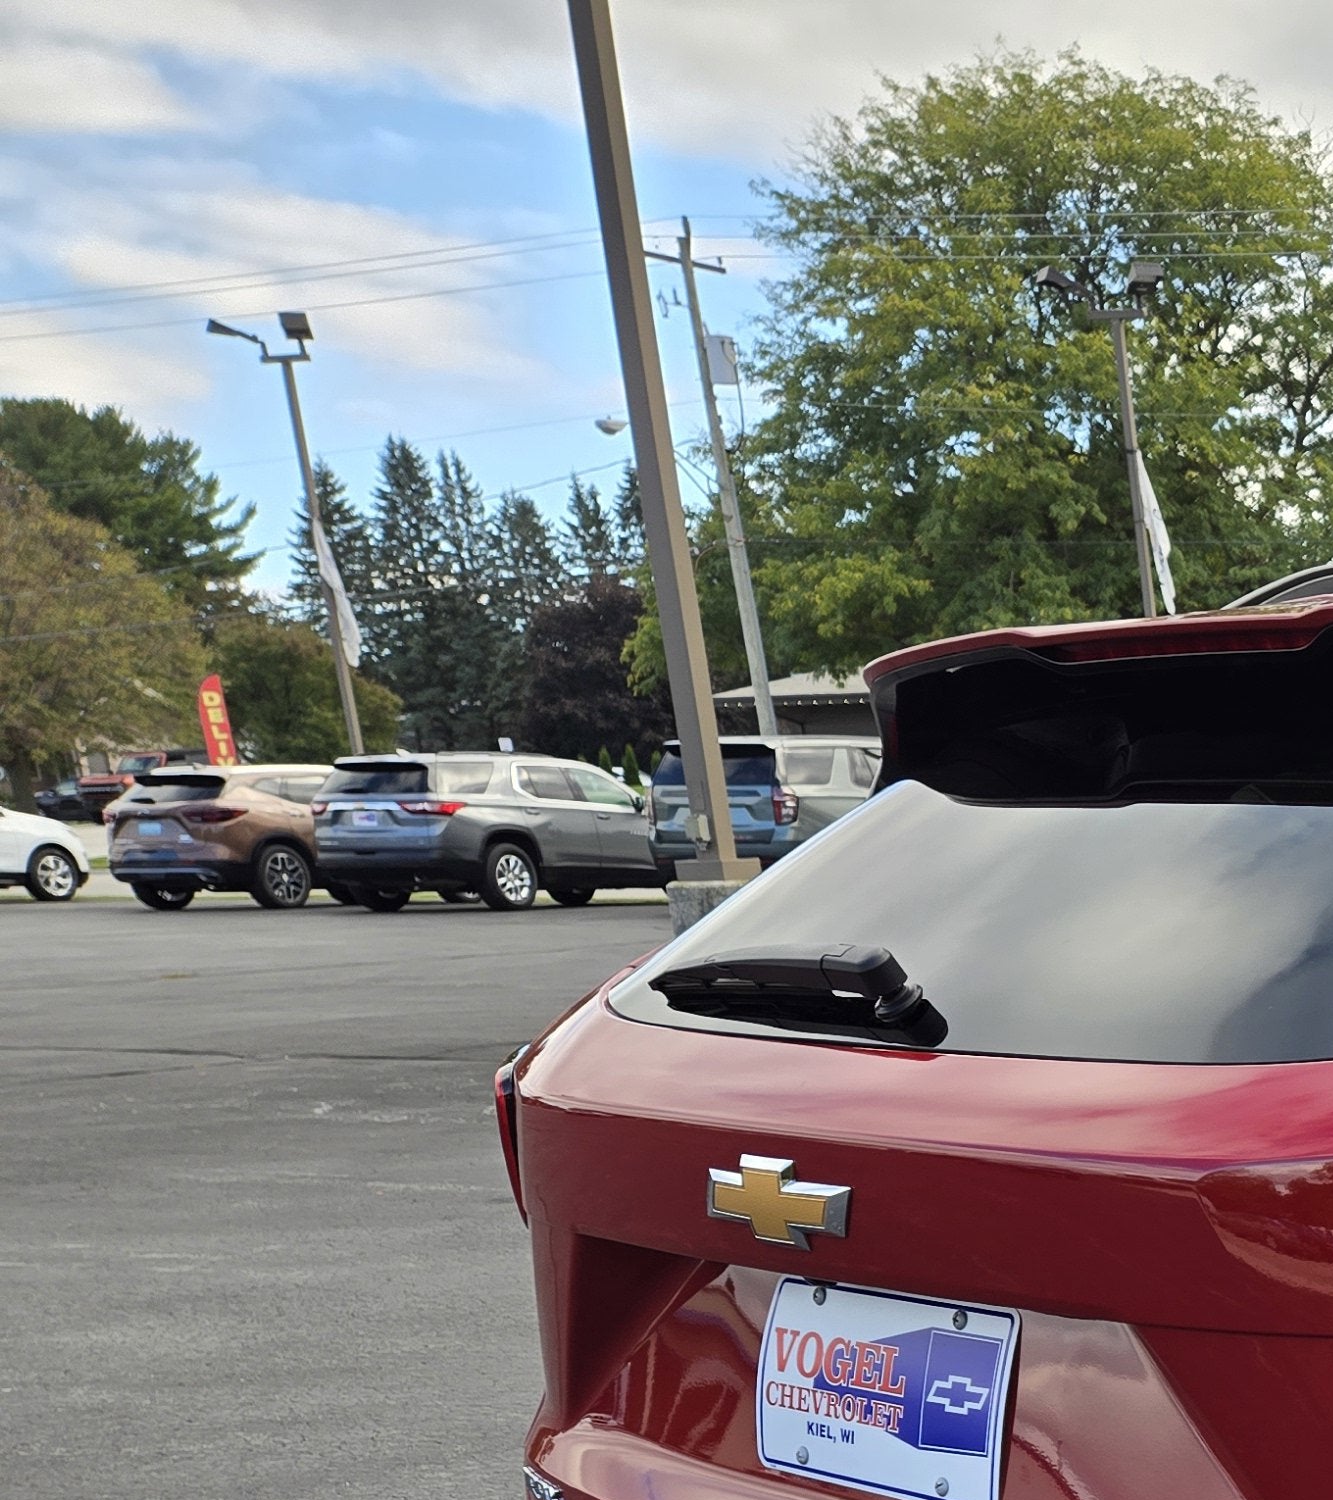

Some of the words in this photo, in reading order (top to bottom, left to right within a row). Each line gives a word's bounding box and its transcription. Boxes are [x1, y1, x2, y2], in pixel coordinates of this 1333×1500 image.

[775, 1327, 905, 1396] VOGEL
[766, 1381, 903, 1432] CHEVROLET
[807, 1421, 836, 1443] KIEL,
[840, 1428, 854, 1444] WI
